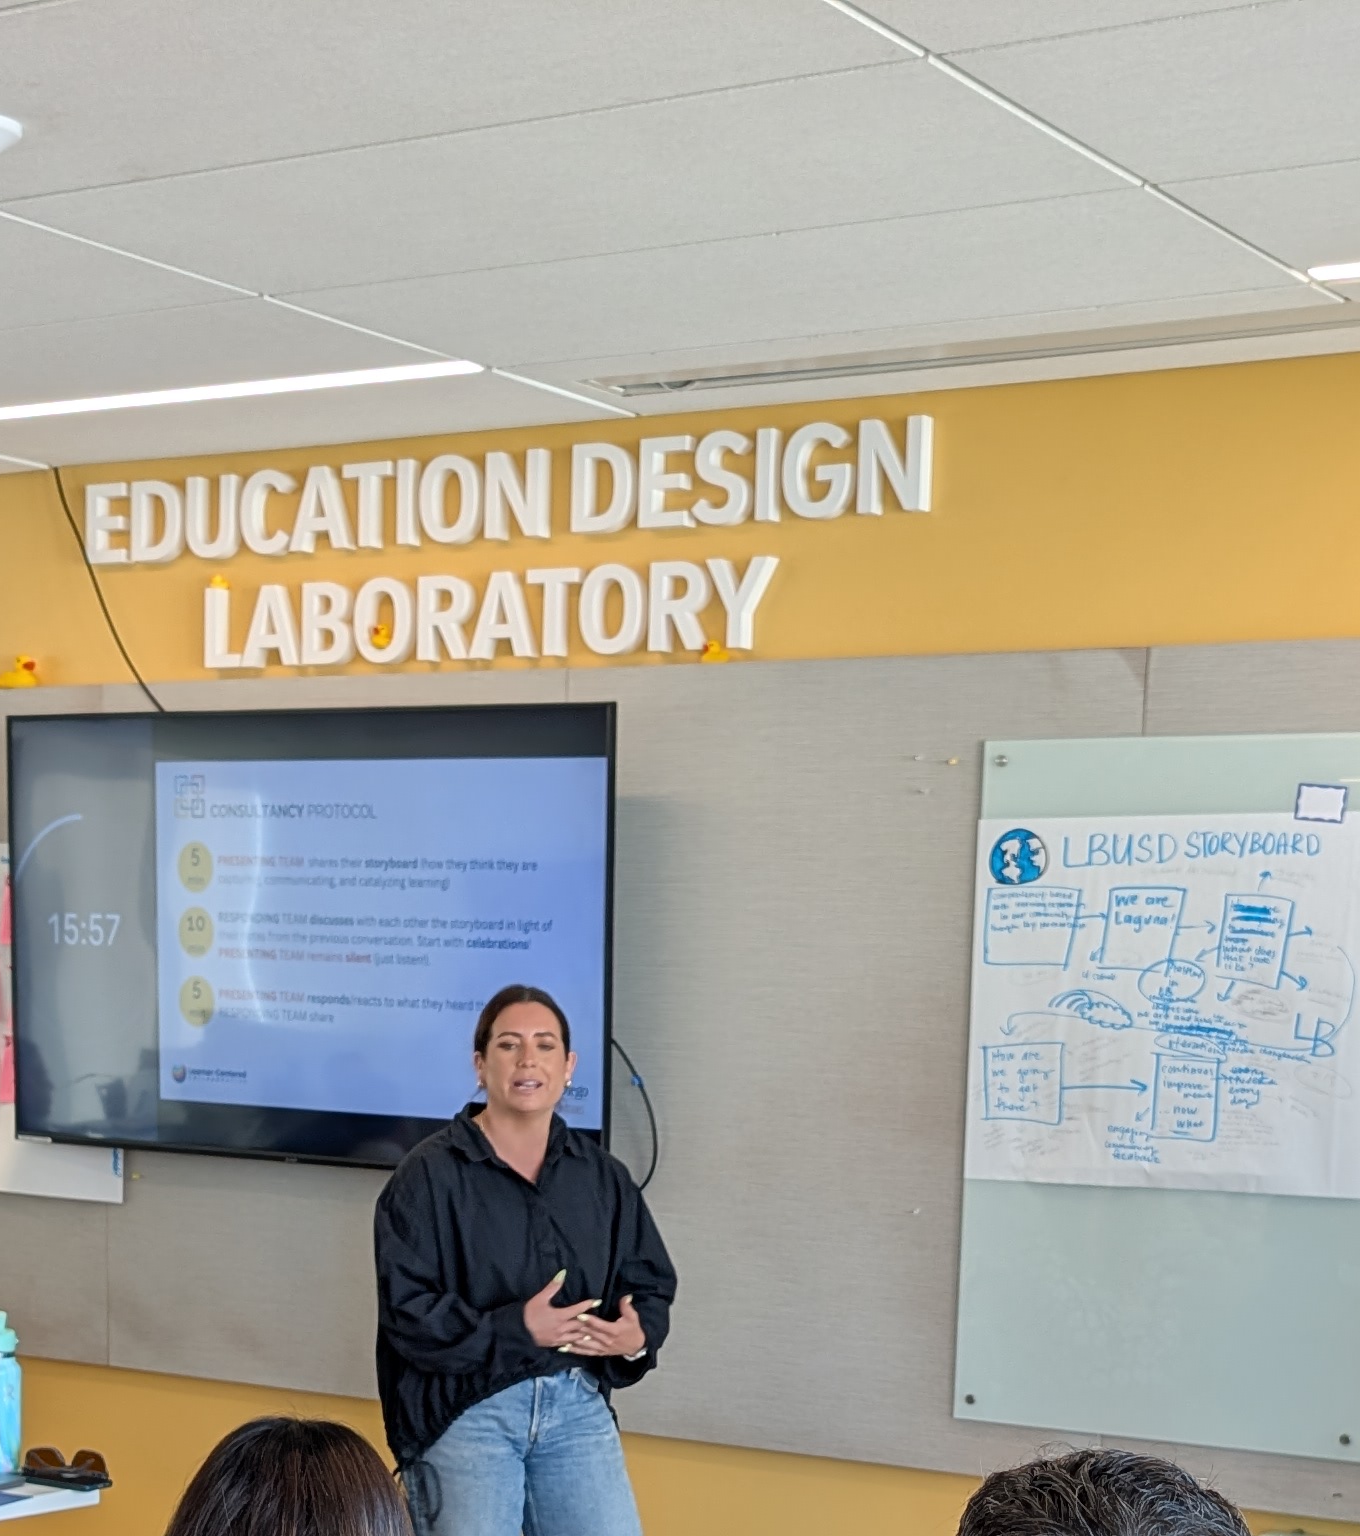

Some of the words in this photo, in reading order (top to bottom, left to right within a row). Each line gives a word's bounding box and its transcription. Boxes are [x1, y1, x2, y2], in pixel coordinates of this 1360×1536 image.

[86, 448, 551, 566] EDUCATION
[571, 415, 934, 535] DESIGN
[203, 556, 780, 669] LABORATORY
[210, 804, 304, 819] CONSULTANCY
[307, 804, 377, 819] PROTOCOL
[191, 848, 200, 867] 5
[1063, 833, 1177, 868] LBUSD
[1184, 831, 1321, 859] STORYBOARD
[365, 857, 418, 871] storyboard
[496, 859, 519, 874] they
[521, 861, 538, 871] are
[48, 912, 120, 945] 15:57
[187, 915, 206, 932] 10
[282, 913, 307, 924] TEAM
[378, 916, 401, 928] each
[403, 917, 429, 929] other
[431, 917, 447, 929] the
[450, 918, 504, 932] storyboard
[517, 919, 539, 934] light
[541, 919, 553, 932] of
[345, 951, 371, 963] silent
[192, 981, 202, 999] 5
[397, 997, 420, 1009] what
[422, 998, 443, 1013] they
[446, 1000, 475, 1011] heard
[282, 1009, 307, 1022] TEAM
